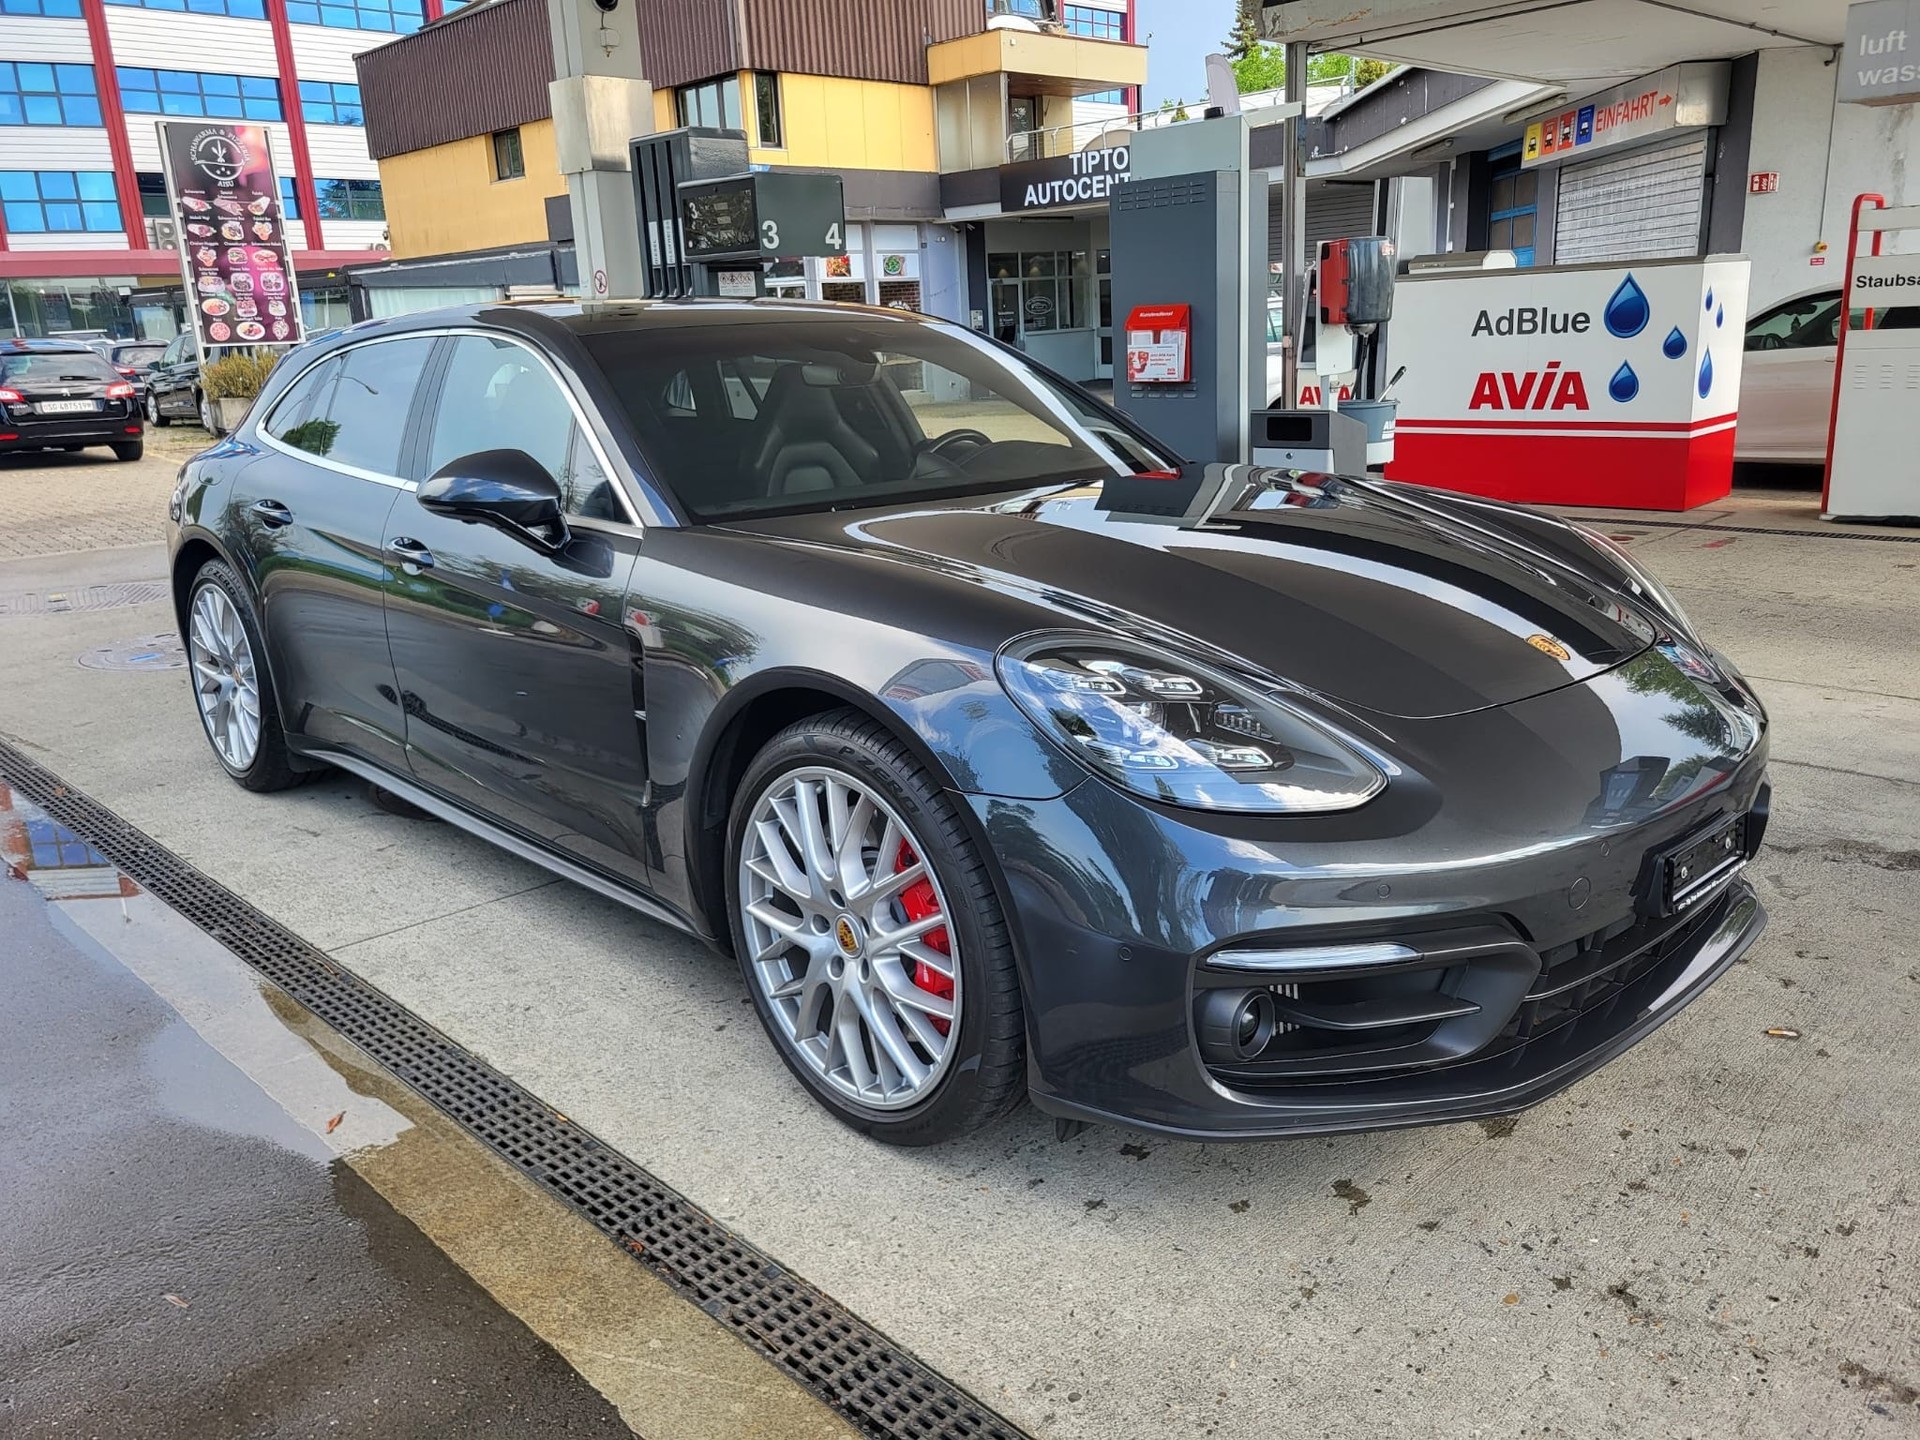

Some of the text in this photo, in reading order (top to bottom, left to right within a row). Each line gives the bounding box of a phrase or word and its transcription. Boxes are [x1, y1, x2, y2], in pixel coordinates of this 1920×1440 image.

[1860, 30, 1907, 56] luft
[1857, 64, 1920, 86] was
[1595, 91, 1658, 132] EINFAHRT
[1068, 147, 1129, 175] TIPTO
[689, 202, 698, 219] 3
[761, 220, 780, 250] 3
[825, 222, 843, 250] 4
[1471, 306, 1591, 337] AdBlue
[1468, 361, 1590, 410] AVIA
[838, 746, 920, 813] P ZERO
